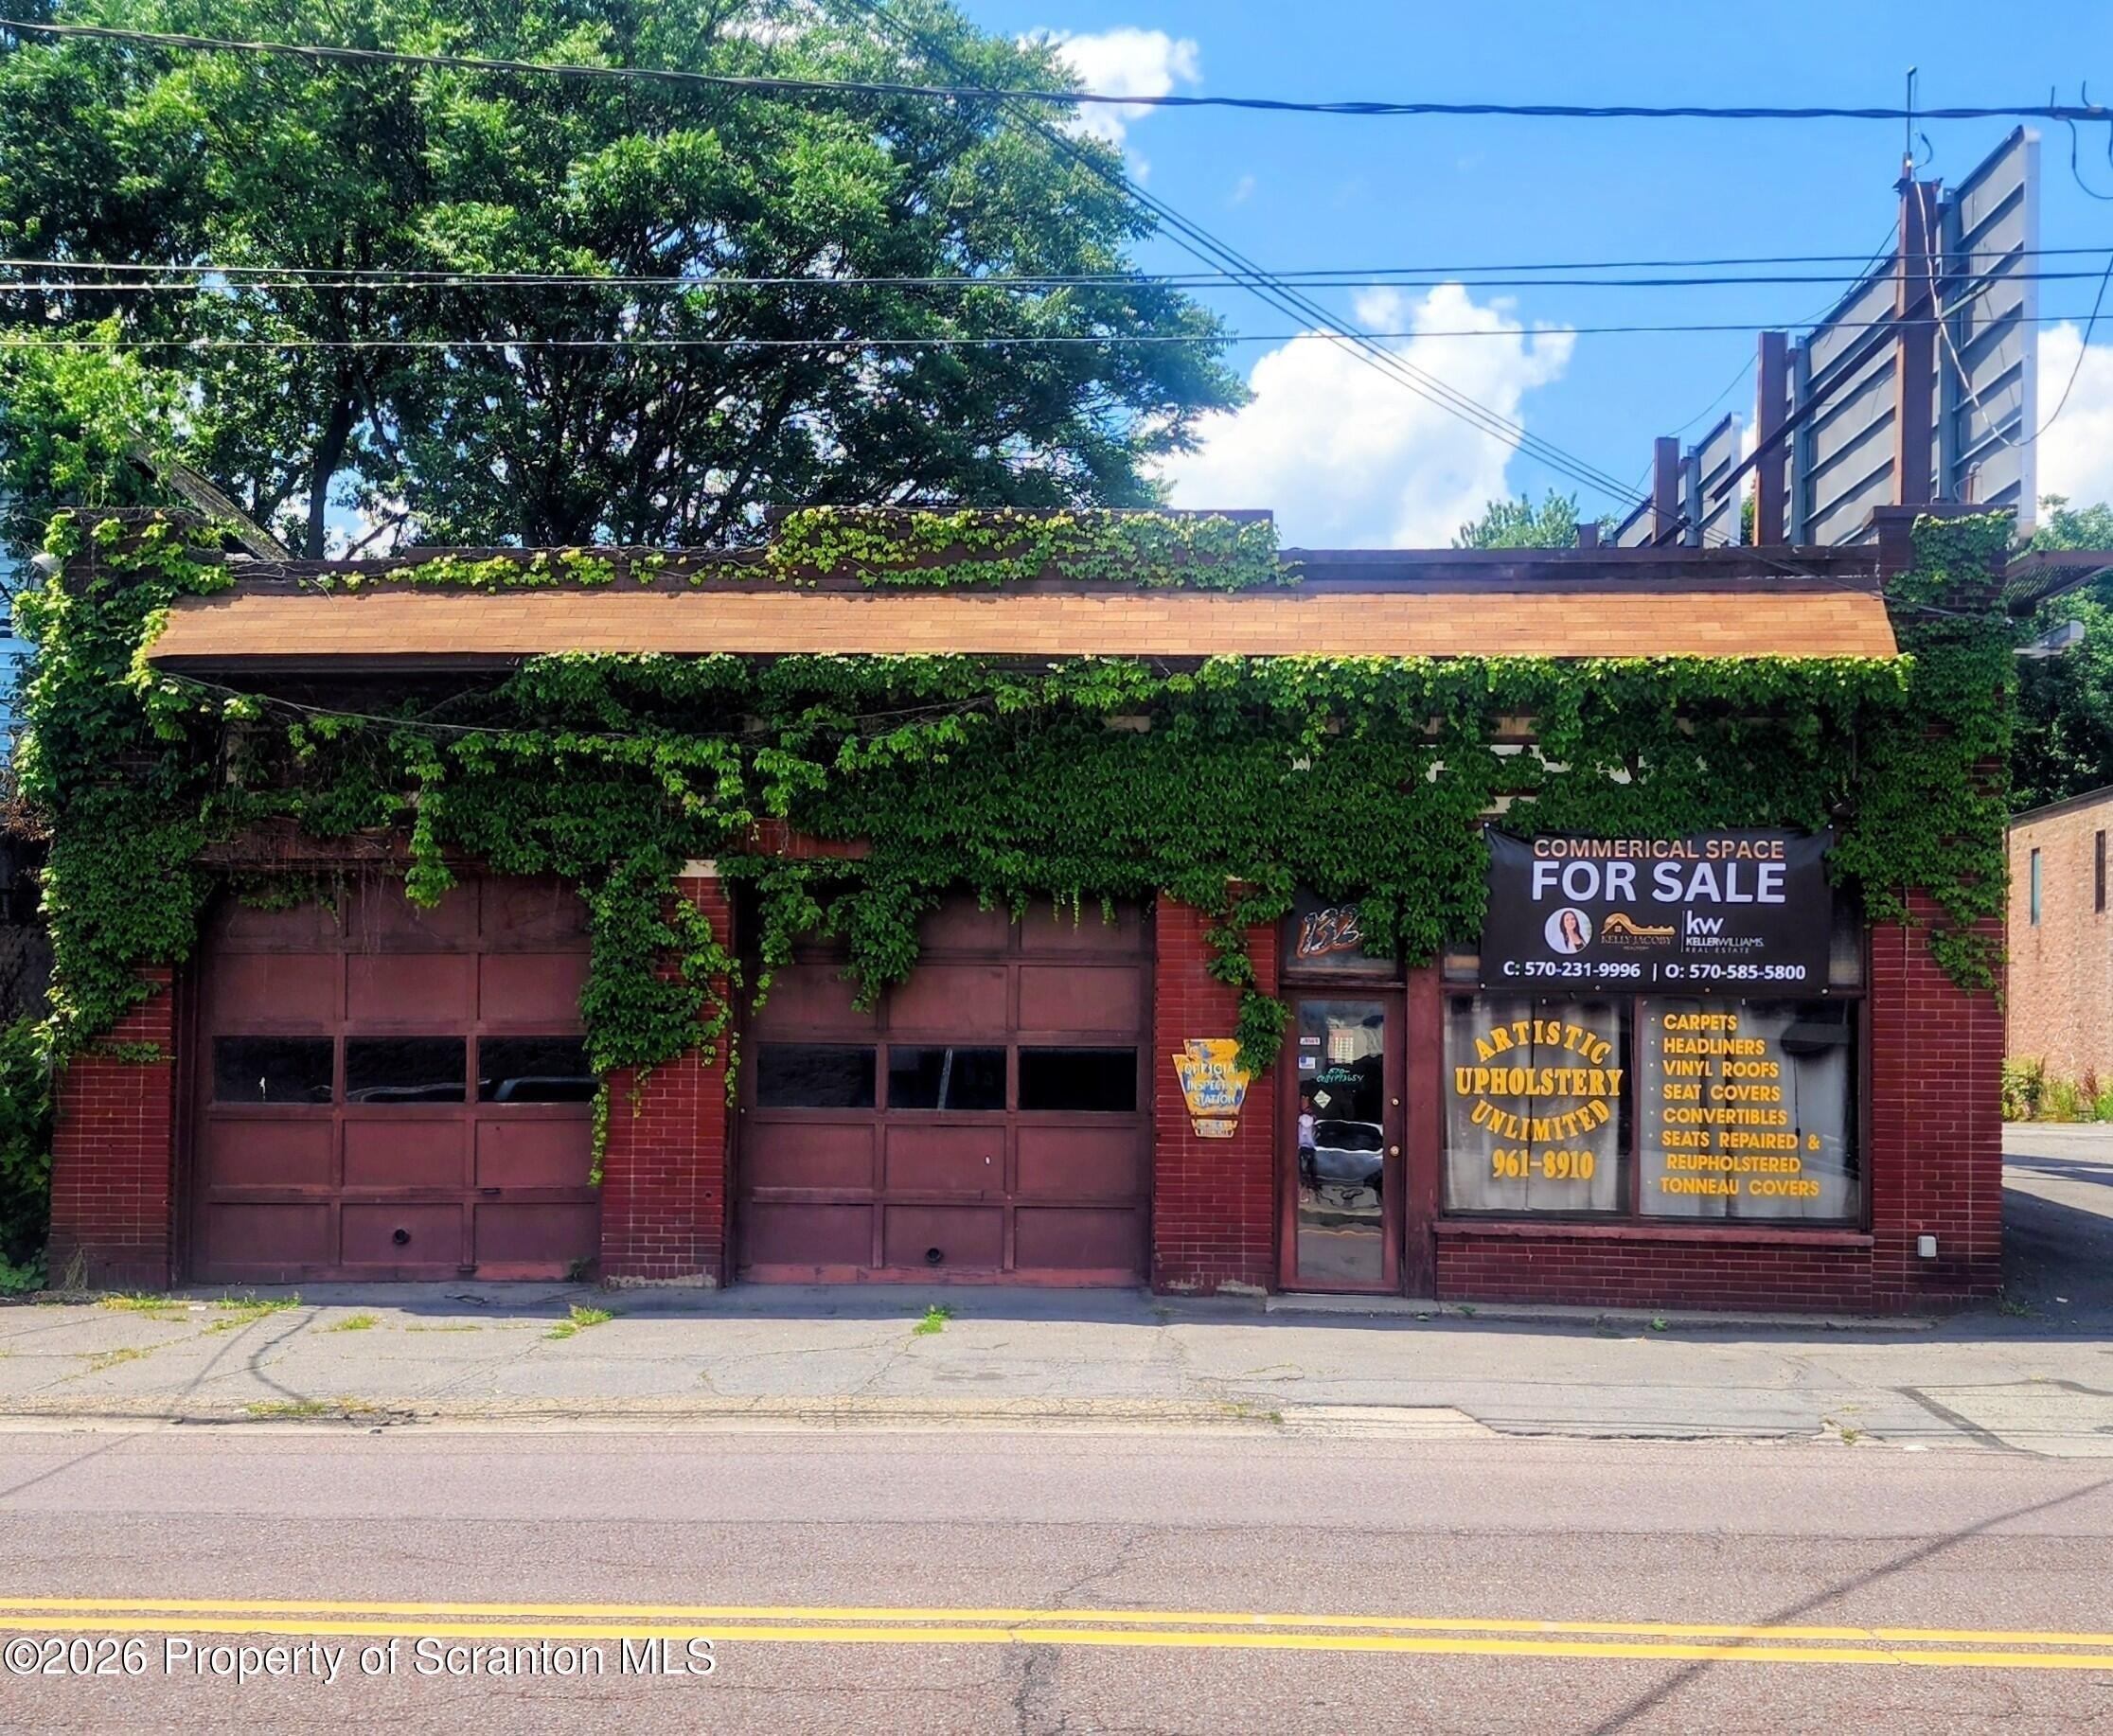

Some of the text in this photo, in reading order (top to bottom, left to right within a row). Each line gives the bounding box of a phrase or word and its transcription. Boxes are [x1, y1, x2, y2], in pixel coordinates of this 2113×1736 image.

[1534, 839, 1785, 859] COMMERICAL SPACE
[1532, 860, 1786, 903] FOR SALE
[1686, 910, 1724, 935] kw
[1601, 935, 1631, 945] KELLY
[1503, 961, 1520, 976] C:
[1524, 961, 1641, 978] 570-231-9996
[1664, 964, 1684, 978] O:
[1689, 964, 1805, 980] 570-585-5800
[1663, 1014, 1738, 1031] CARPETS
[1474, 1019, 1612, 1066] ARTISTIC
[1663, 1037, 1766, 1055] HEADLINERS
[1662, 1059, 1779, 1078] VINYL ROOFS
[1454, 1067, 1625, 1097] UPHOLSTERY
[1662, 1083, 1782, 1102] SEAT COVERS
[1470, 1098, 1611, 1143] UNLIMITED
[1662, 1107, 1788, 1125] CONVERTIBLES
[1661, 1130, 1820, 1150] SEATS REPAIRED &
[1492, 1148, 1595, 1179] 961-8910
[1666, 1153, 1802, 1173] REUPHOLSTERED
[1660, 1177, 1820, 1196] TONNEAU COVERS
